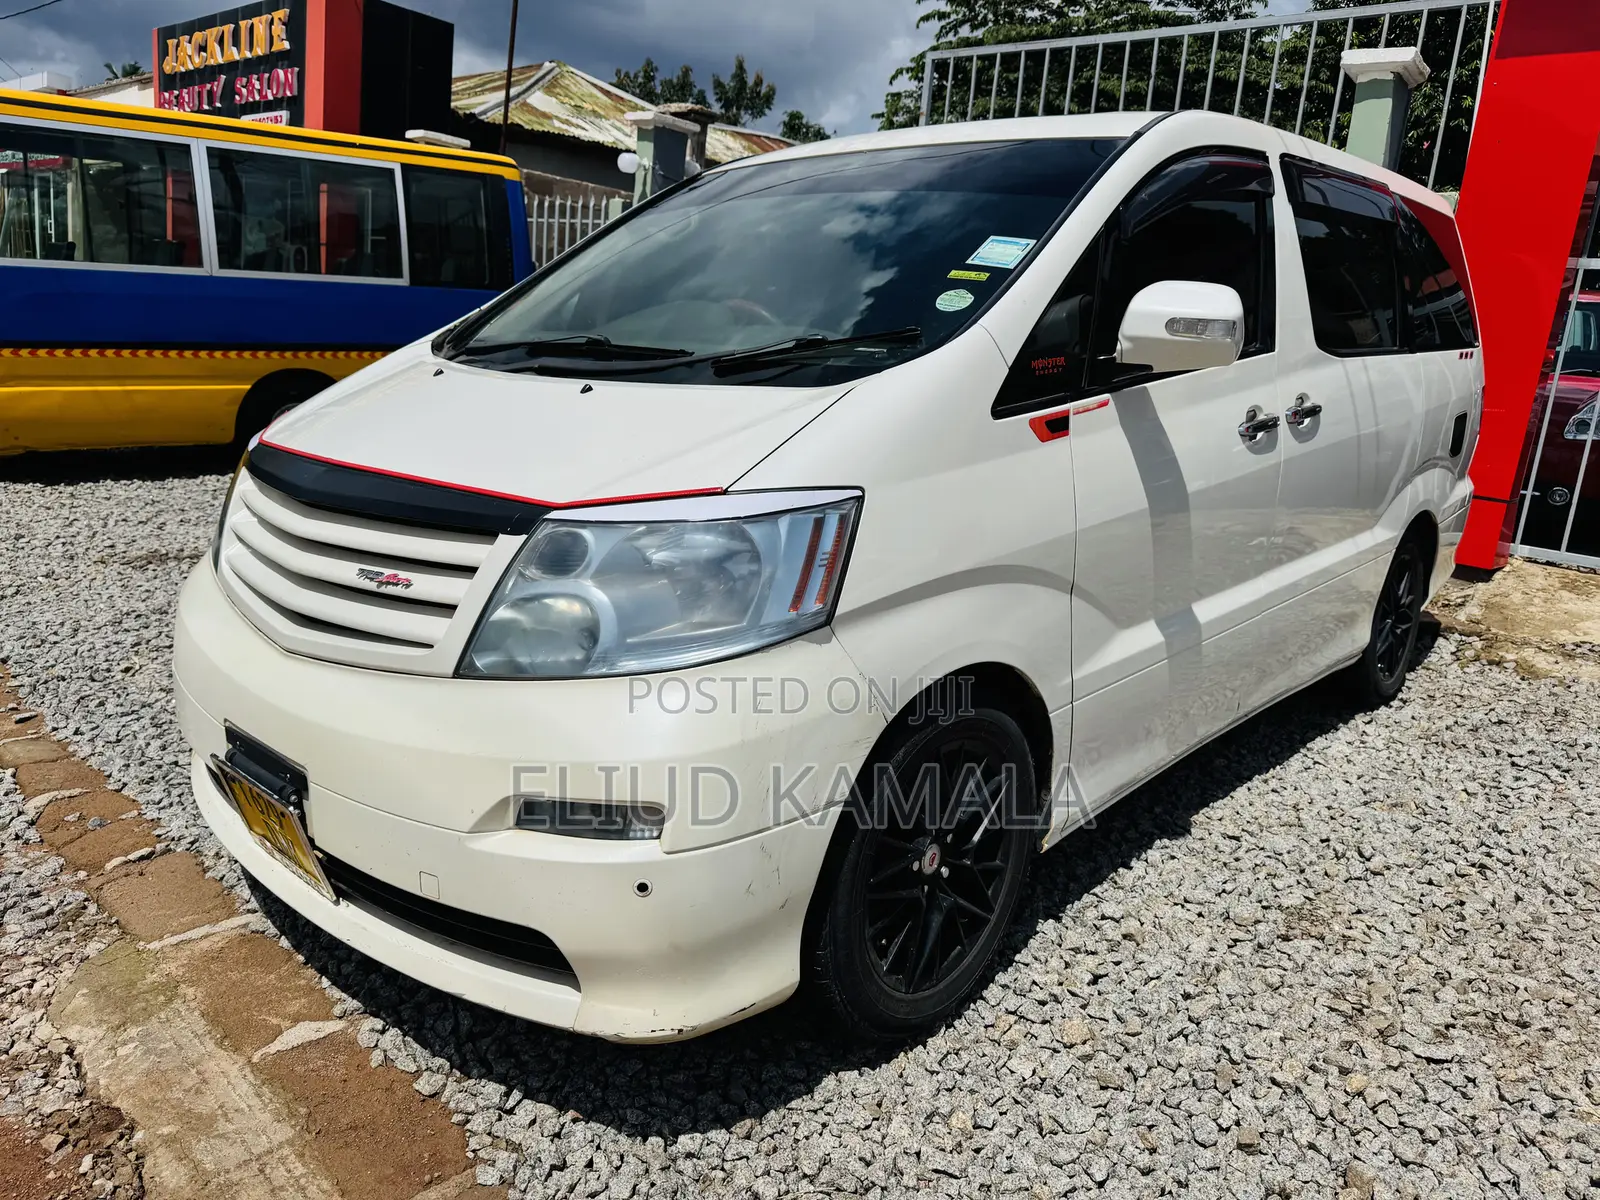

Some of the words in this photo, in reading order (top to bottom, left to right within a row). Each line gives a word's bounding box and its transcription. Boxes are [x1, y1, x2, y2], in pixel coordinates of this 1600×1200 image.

[162, 8, 291, 75] JACKLINE
[159, 74, 226, 112] BEAUTY
[234, 67, 300, 105] SALON
[1031, 357, 1067, 370] MONSTER
